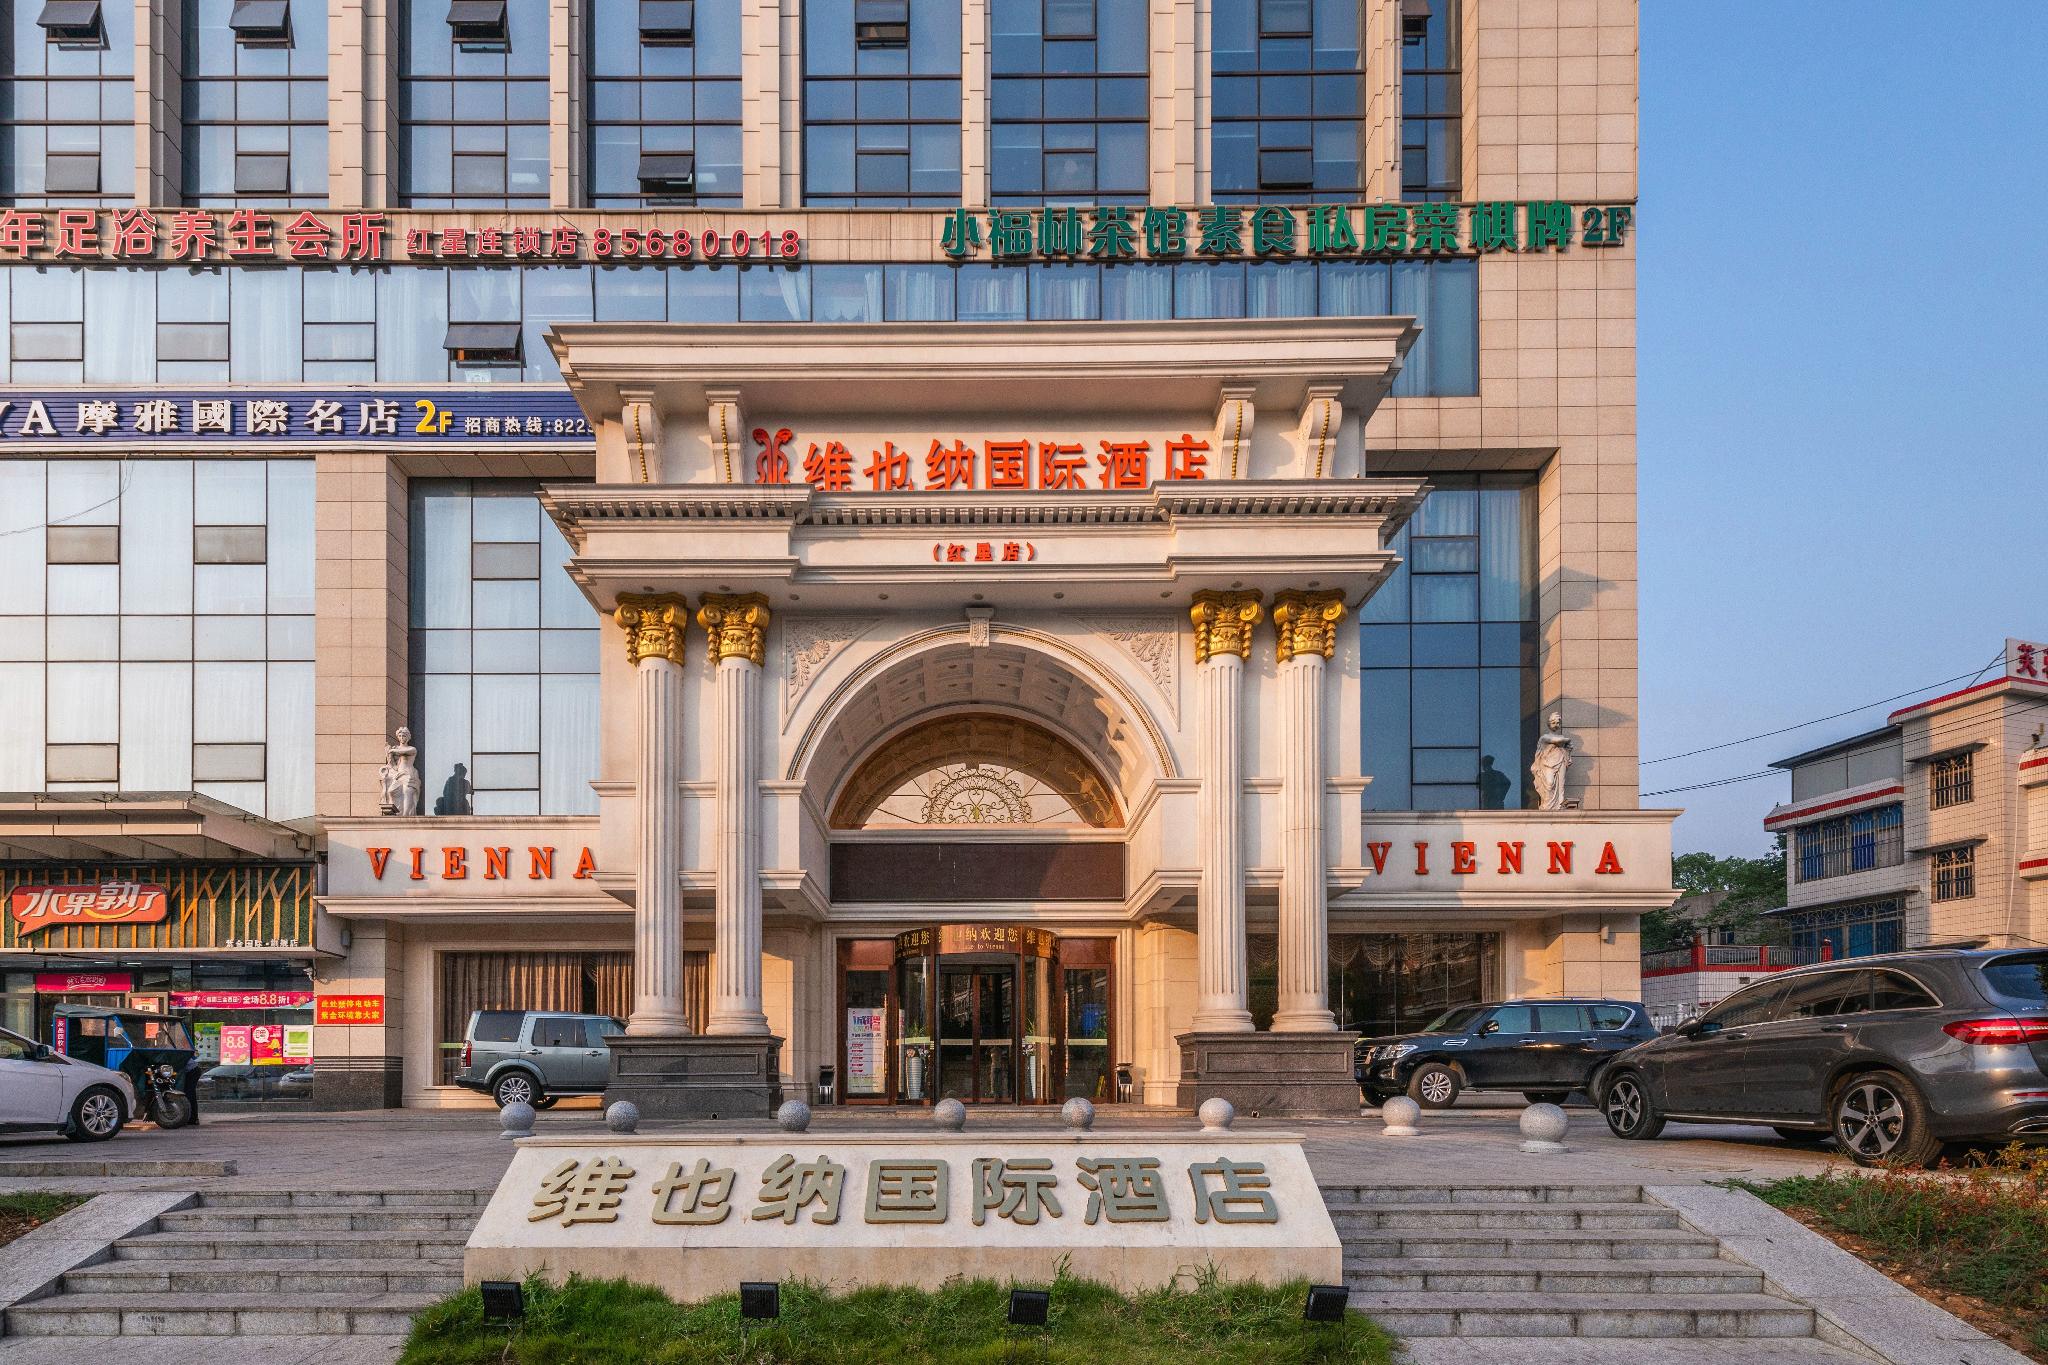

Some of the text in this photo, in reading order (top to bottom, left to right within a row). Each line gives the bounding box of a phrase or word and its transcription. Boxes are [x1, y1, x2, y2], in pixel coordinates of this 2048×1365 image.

[0, 208, 801, 261] 年足浴养生会所 红星连锁店 85680018
[1581, 206, 1632, 248] 2F
[76, 399, 400, 435] 摩雅國際名店
[415, 399, 453, 434] 2F
[802, 433, 1211, 491] 维也纳国际酒店
[365, 846, 599, 880] VIENNA
[1366, 841, 1625, 875] VIENNA
[19, 881, 161, 918] 水果熟了
[526, 1153, 1281, 1227] 维也纳国际酒店
